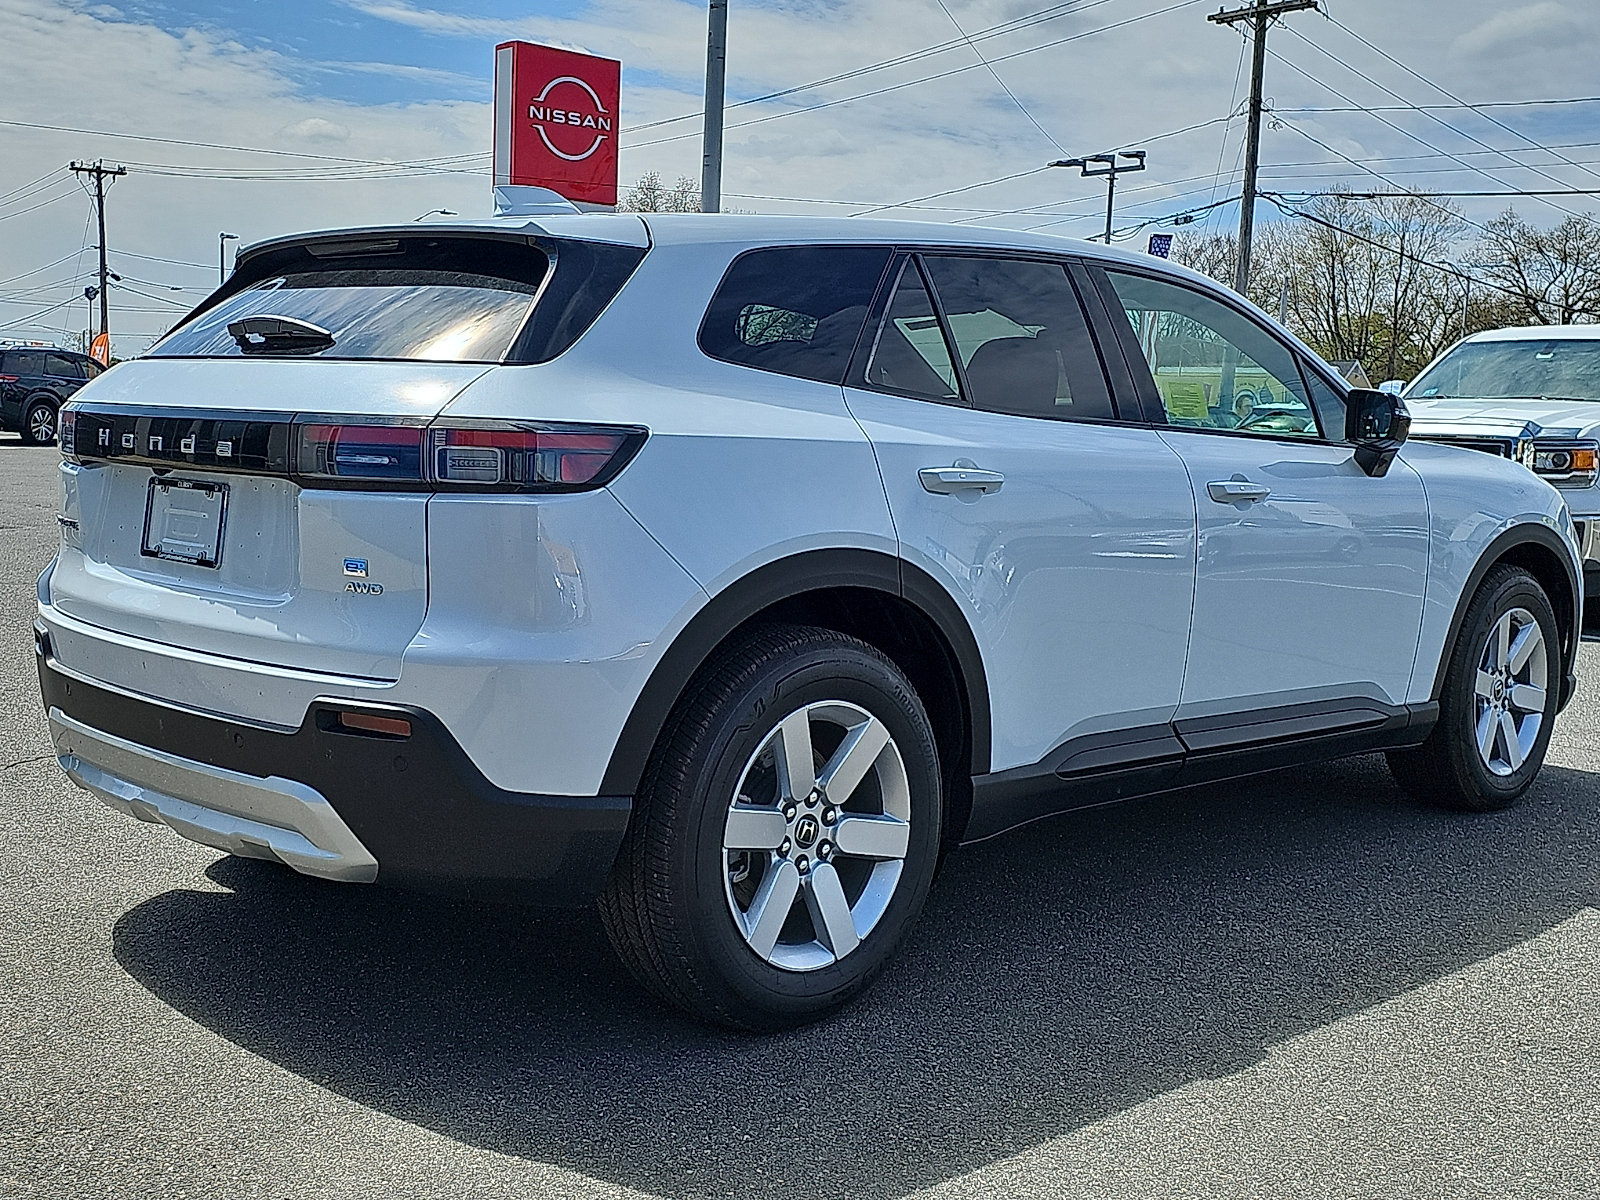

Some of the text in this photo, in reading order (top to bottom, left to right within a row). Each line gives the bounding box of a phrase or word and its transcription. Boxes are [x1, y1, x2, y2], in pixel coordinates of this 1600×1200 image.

[529, 105, 611, 131] NISSAN
[98, 428, 232, 457] Honda
[344, 582, 383, 595] AWD
